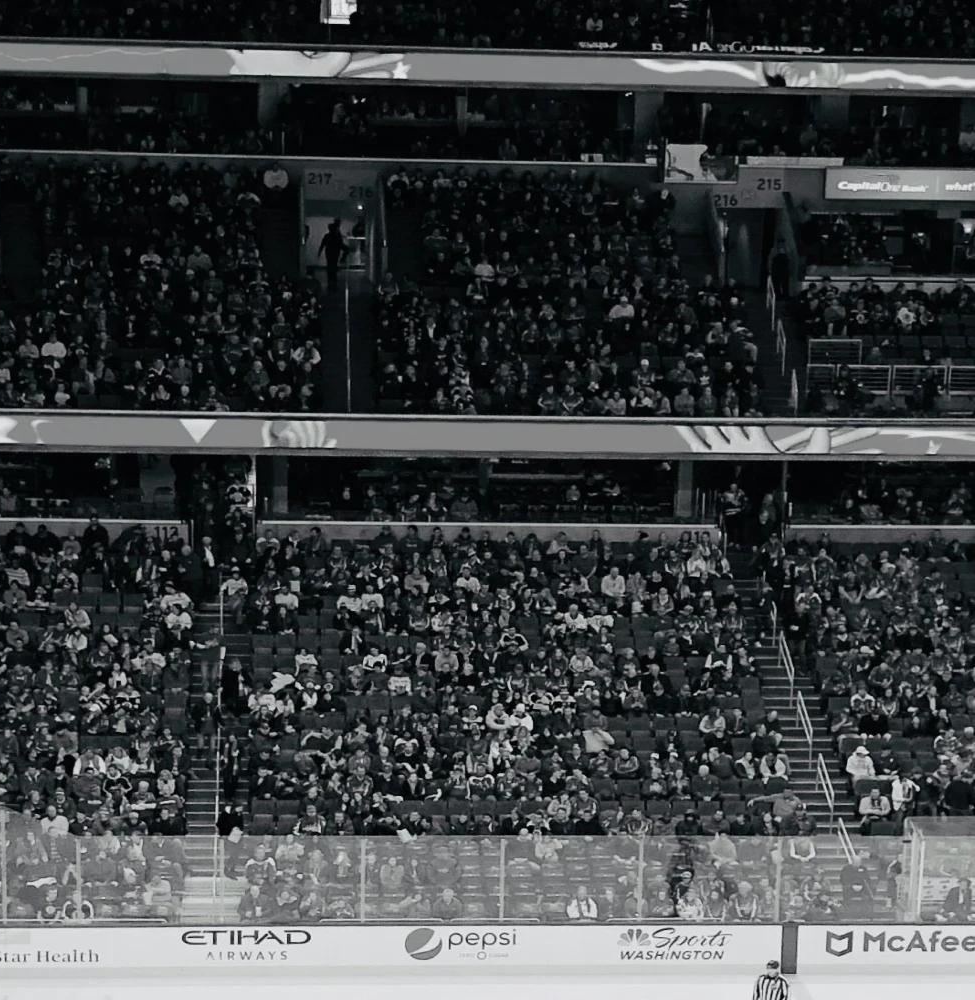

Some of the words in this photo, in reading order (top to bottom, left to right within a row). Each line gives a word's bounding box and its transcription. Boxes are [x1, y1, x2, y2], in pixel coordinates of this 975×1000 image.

[308, 173, 332, 185] 217
[757, 178, 782, 190] 215
[349, 186, 373, 198] 216
[713, 194, 738, 206] 216
[181, 930, 312, 945] ETIHAD
[448, 929, 517, 950] pepsi
[652, 927, 733, 950] Sports
[863, 930, 975, 952] McAfee
[37, 949, 99, 962] Health
[205, 951, 288, 960] AIRWAYS
[620, 950, 725, 960] WASHINGTON
